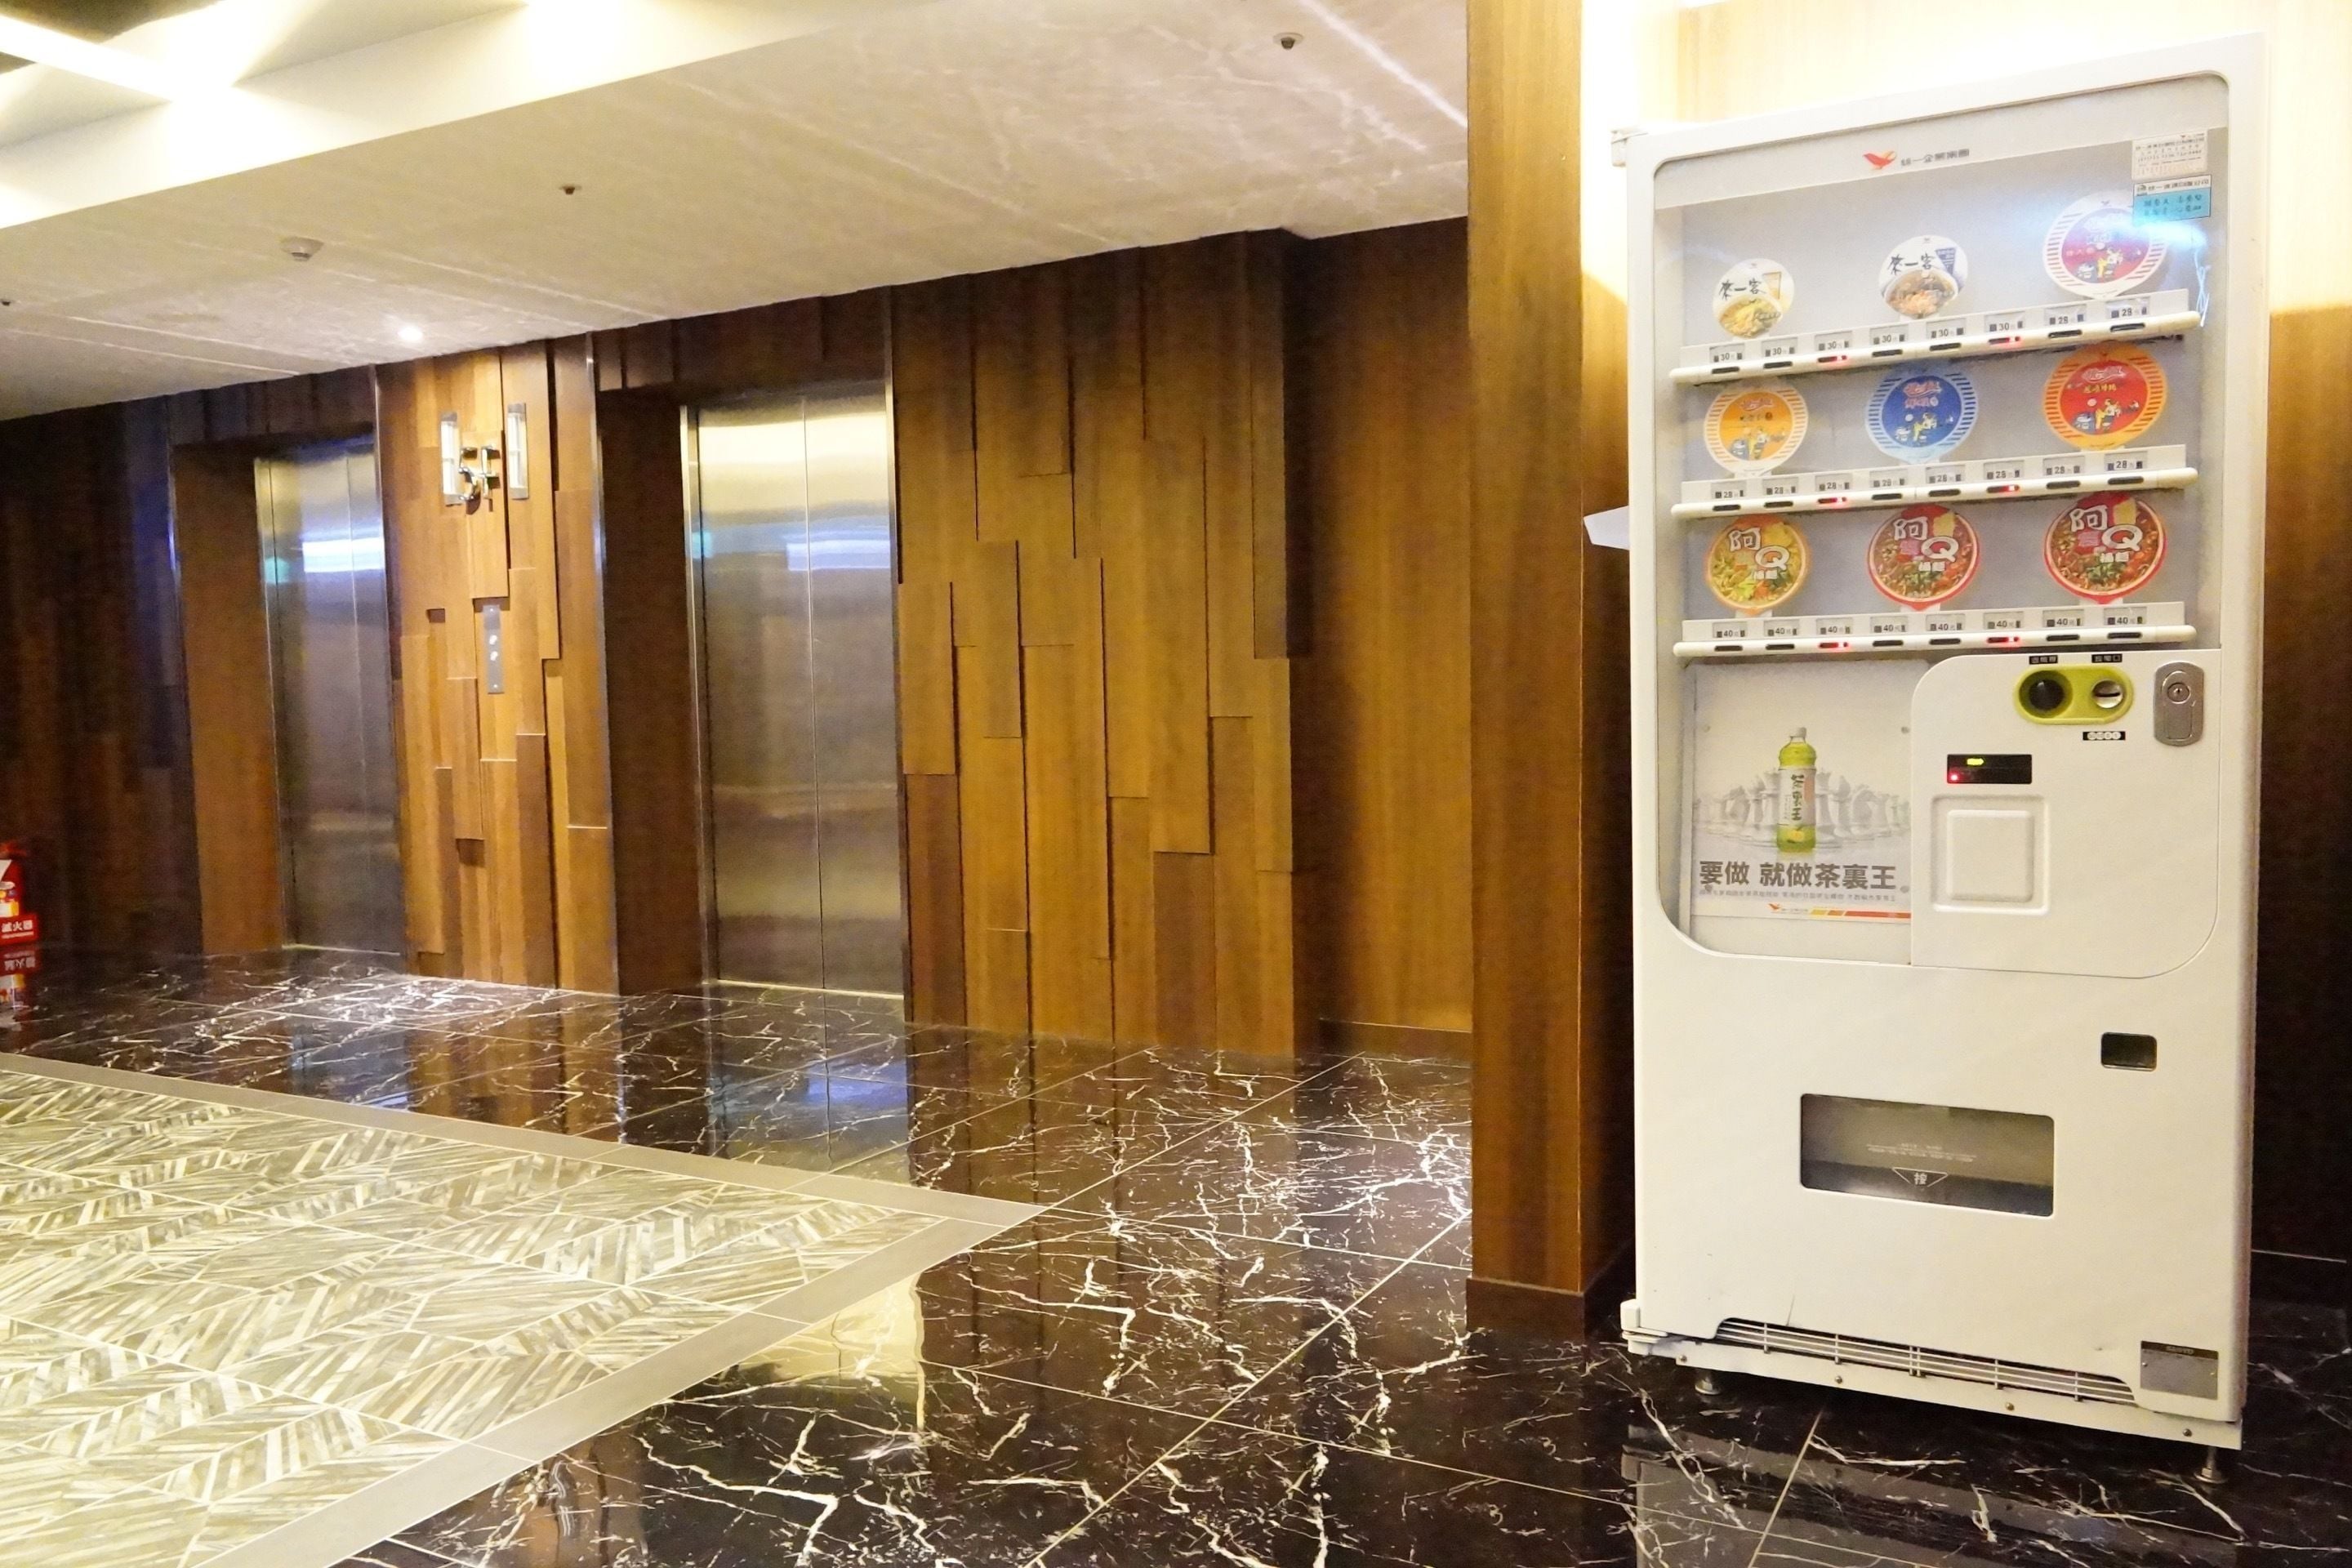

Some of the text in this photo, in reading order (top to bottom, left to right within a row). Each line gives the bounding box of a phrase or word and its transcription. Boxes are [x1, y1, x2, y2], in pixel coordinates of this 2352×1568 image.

[1699, 860, 1896, 890] 要做 就做茶裏王
